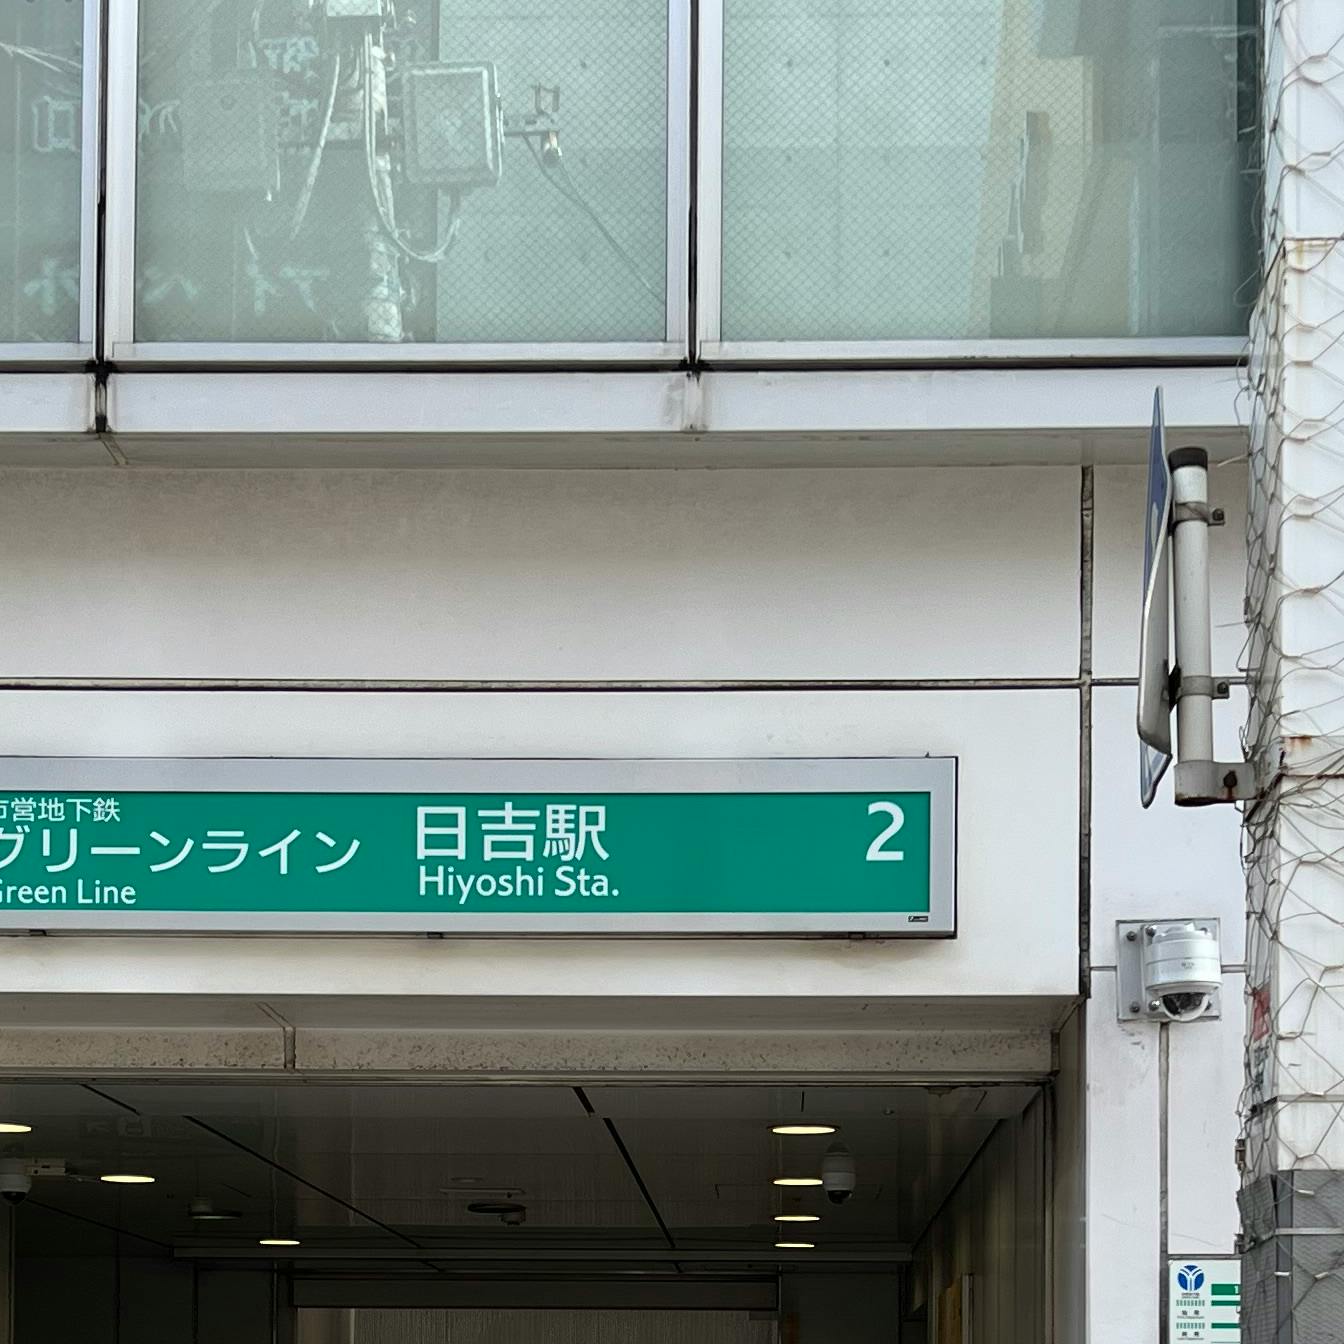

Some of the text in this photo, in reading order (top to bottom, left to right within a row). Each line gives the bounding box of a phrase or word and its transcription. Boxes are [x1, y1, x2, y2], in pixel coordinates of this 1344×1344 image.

[415, 801, 610, 862] 日吉駅
[865, 801, 906, 861] 2
[76, 878, 137, 905] Line
[418, 865, 620, 905] Hiyoshi Sta.
